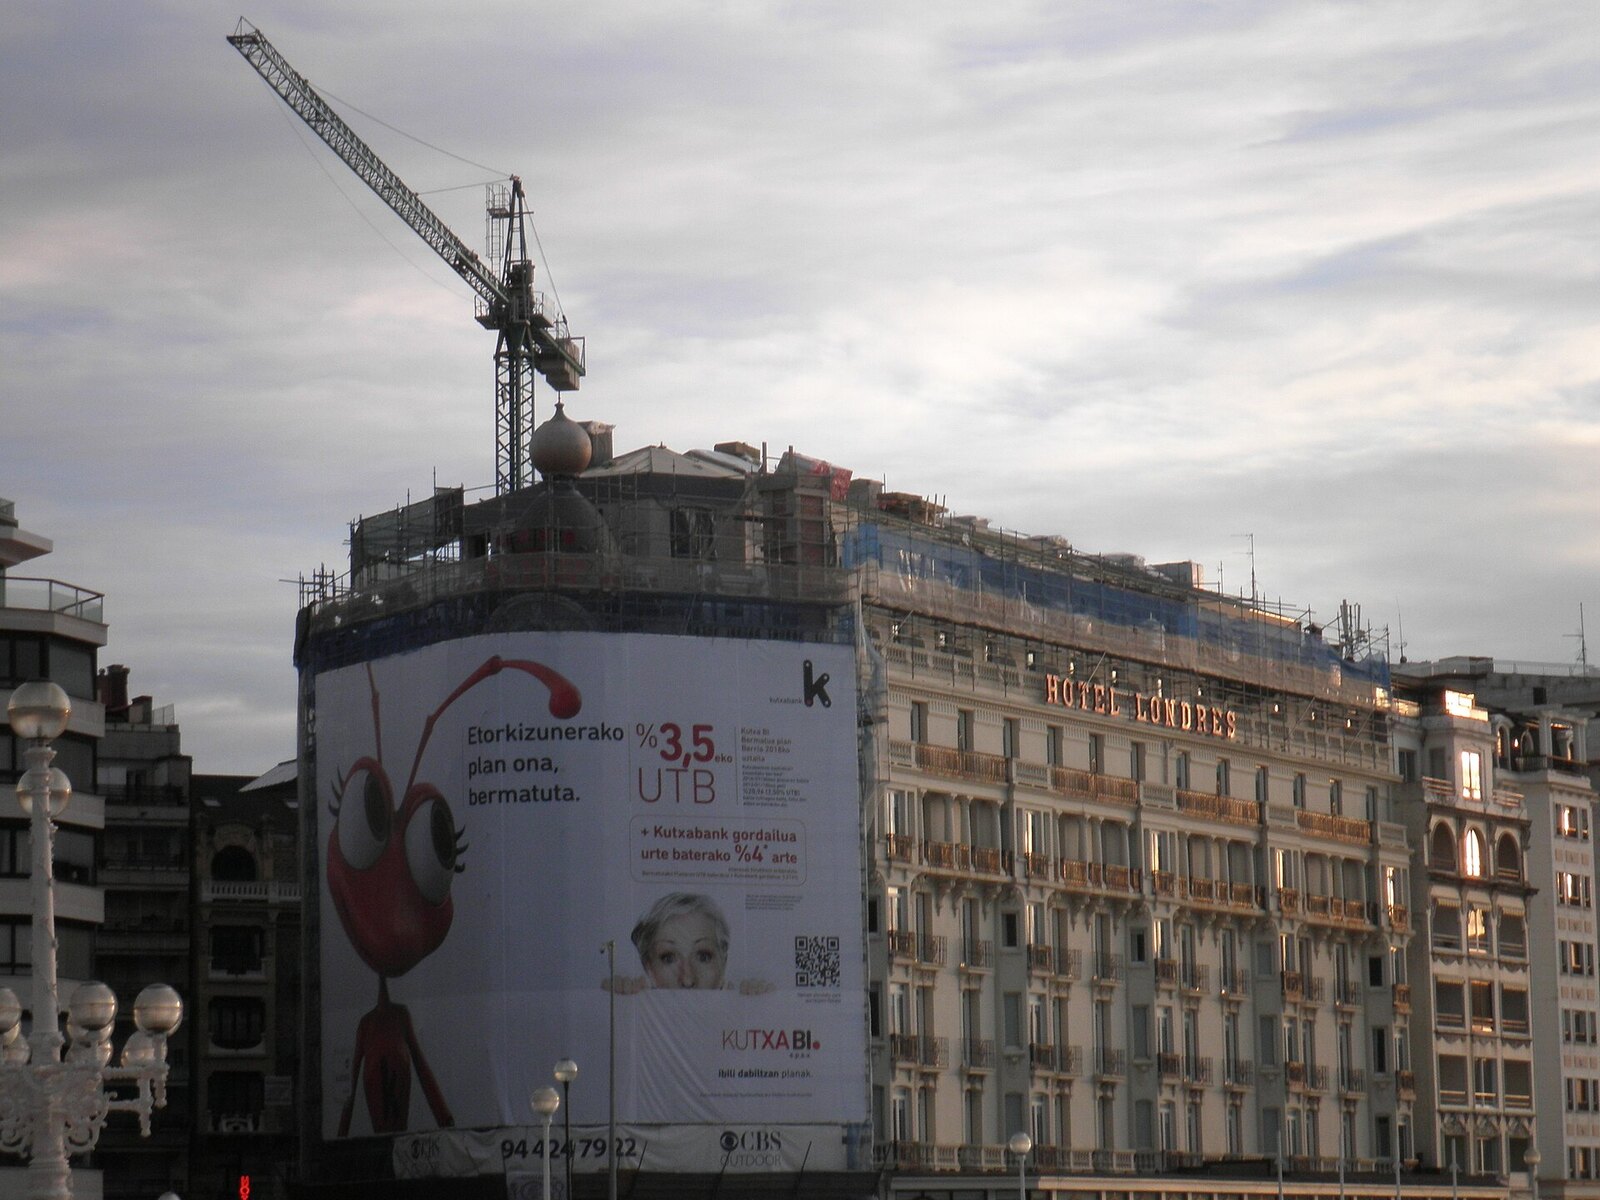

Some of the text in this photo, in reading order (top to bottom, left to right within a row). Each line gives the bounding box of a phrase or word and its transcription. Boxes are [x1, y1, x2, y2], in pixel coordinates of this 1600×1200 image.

[1046, 673, 1236, 739] HOTEL LONDRES
[468, 722, 624, 745] Etorkizunerako
[468, 756, 559, 780] plan ona,
[469, 784, 581, 806] bermatuta.
[638, 767, 715, 804] UTB
[653, 825, 728, 841] Kutxabank
[732, 828, 797, 843] gordailua
[641, 848, 669, 860] urte
[672, 847, 731, 862] baterako
[772, 852, 798, 864] arte
[738, 1068, 779, 1079] dabiltzan
[501, 1139, 528, 1159] 94
[578, 1137, 606, 1158] 79
[740, 1131, 782, 1151] CBS
[719, 1153, 782, 1167] OUTDOOR
